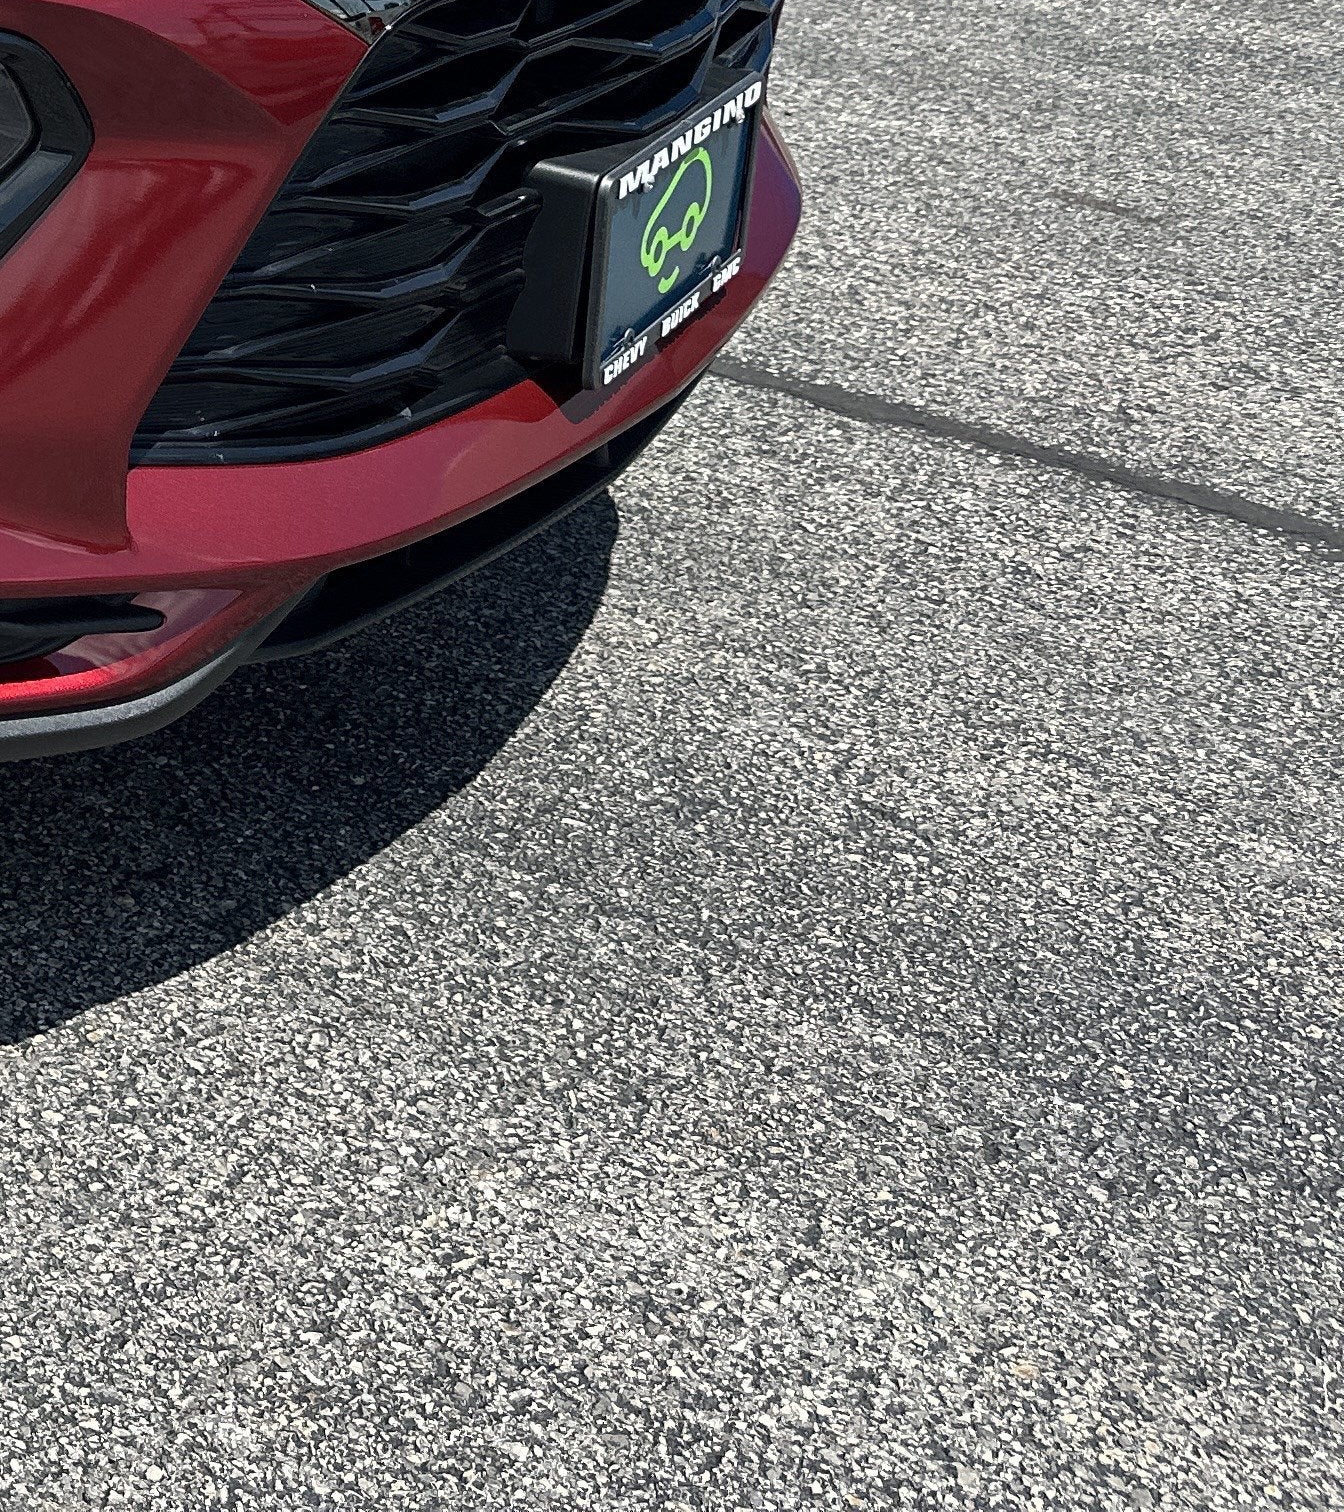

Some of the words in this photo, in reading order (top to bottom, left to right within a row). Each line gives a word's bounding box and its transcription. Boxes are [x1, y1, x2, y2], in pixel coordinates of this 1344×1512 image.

[618, 81, 762, 199] MANGINO
[603, 336, 648, 385] CHEVY
[662, 292, 700, 337] BUICK
[712, 256, 742, 293] GMC
